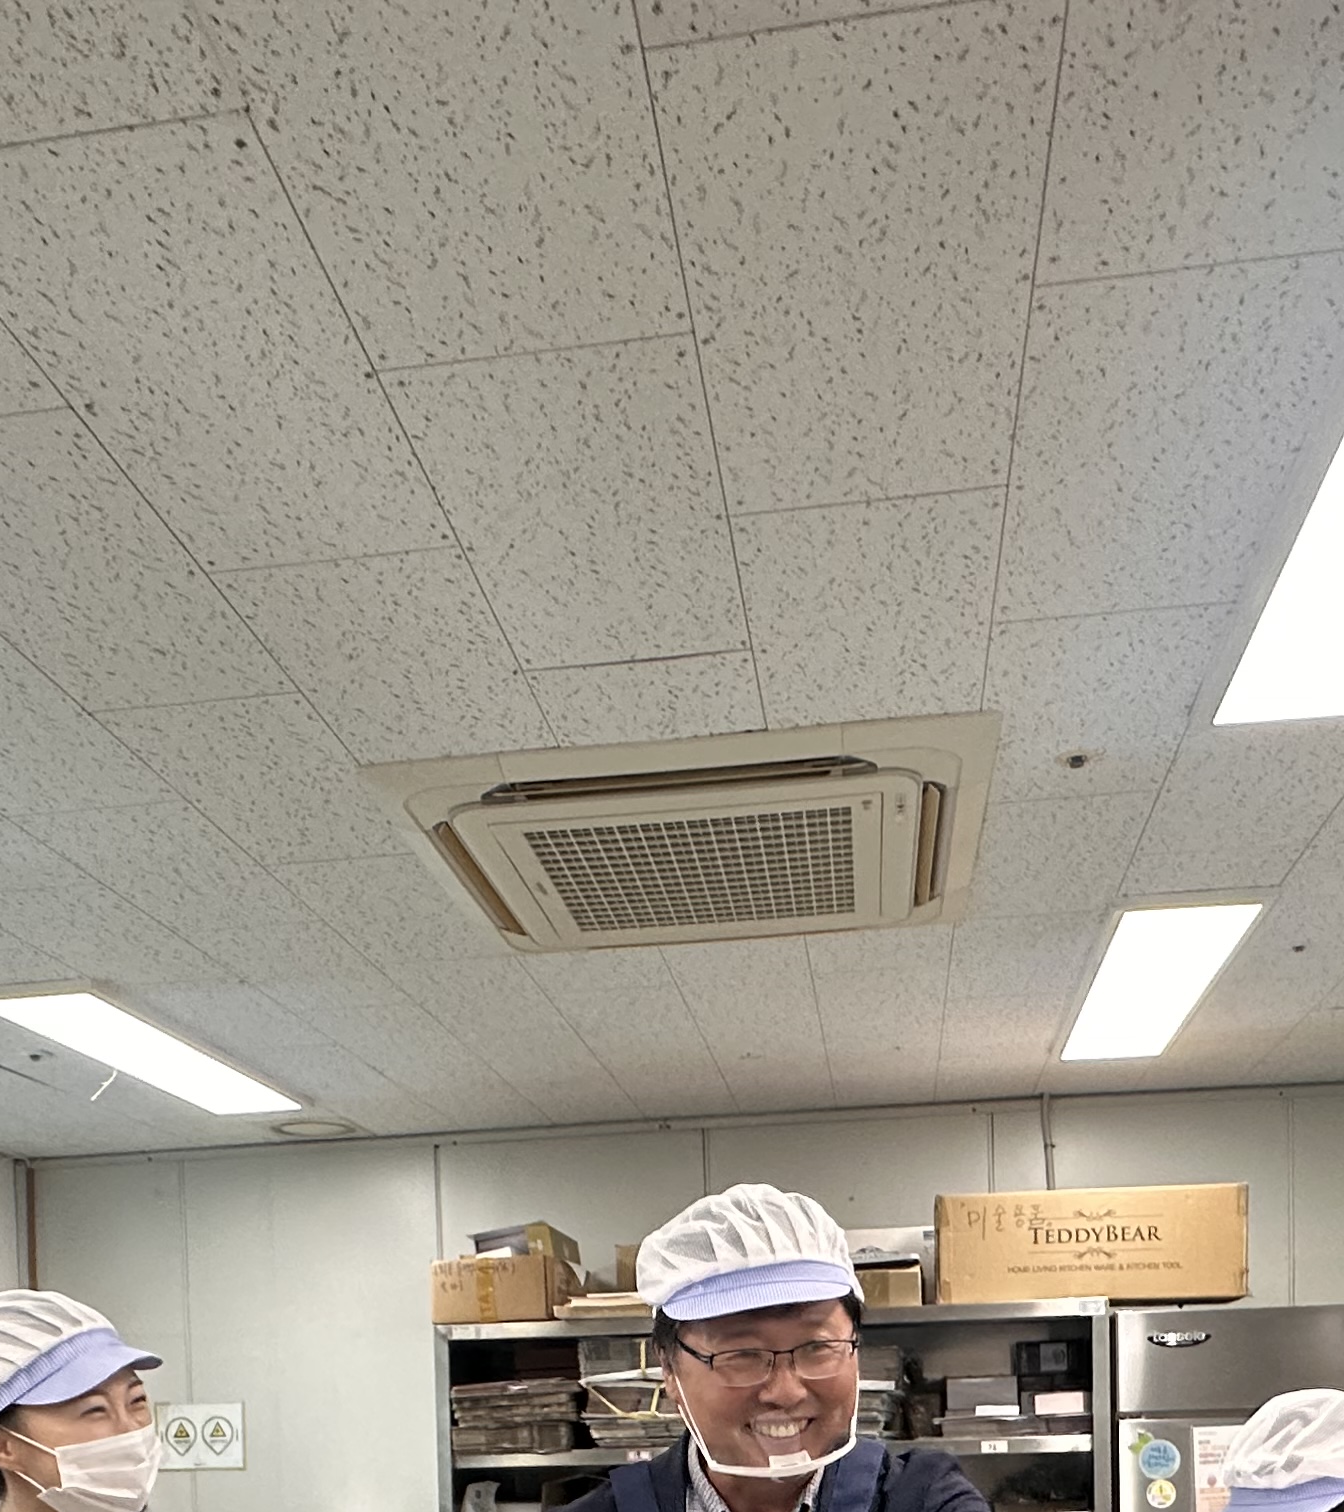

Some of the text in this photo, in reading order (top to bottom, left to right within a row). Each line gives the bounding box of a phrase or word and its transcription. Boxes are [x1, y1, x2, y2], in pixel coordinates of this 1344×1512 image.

[1029, 1224, 1163, 1246] TEDDYBEAR
[1032, 1264, 1057, 1274] LIVING
[1059, 1264, 1092, 1273] KITCHEN
